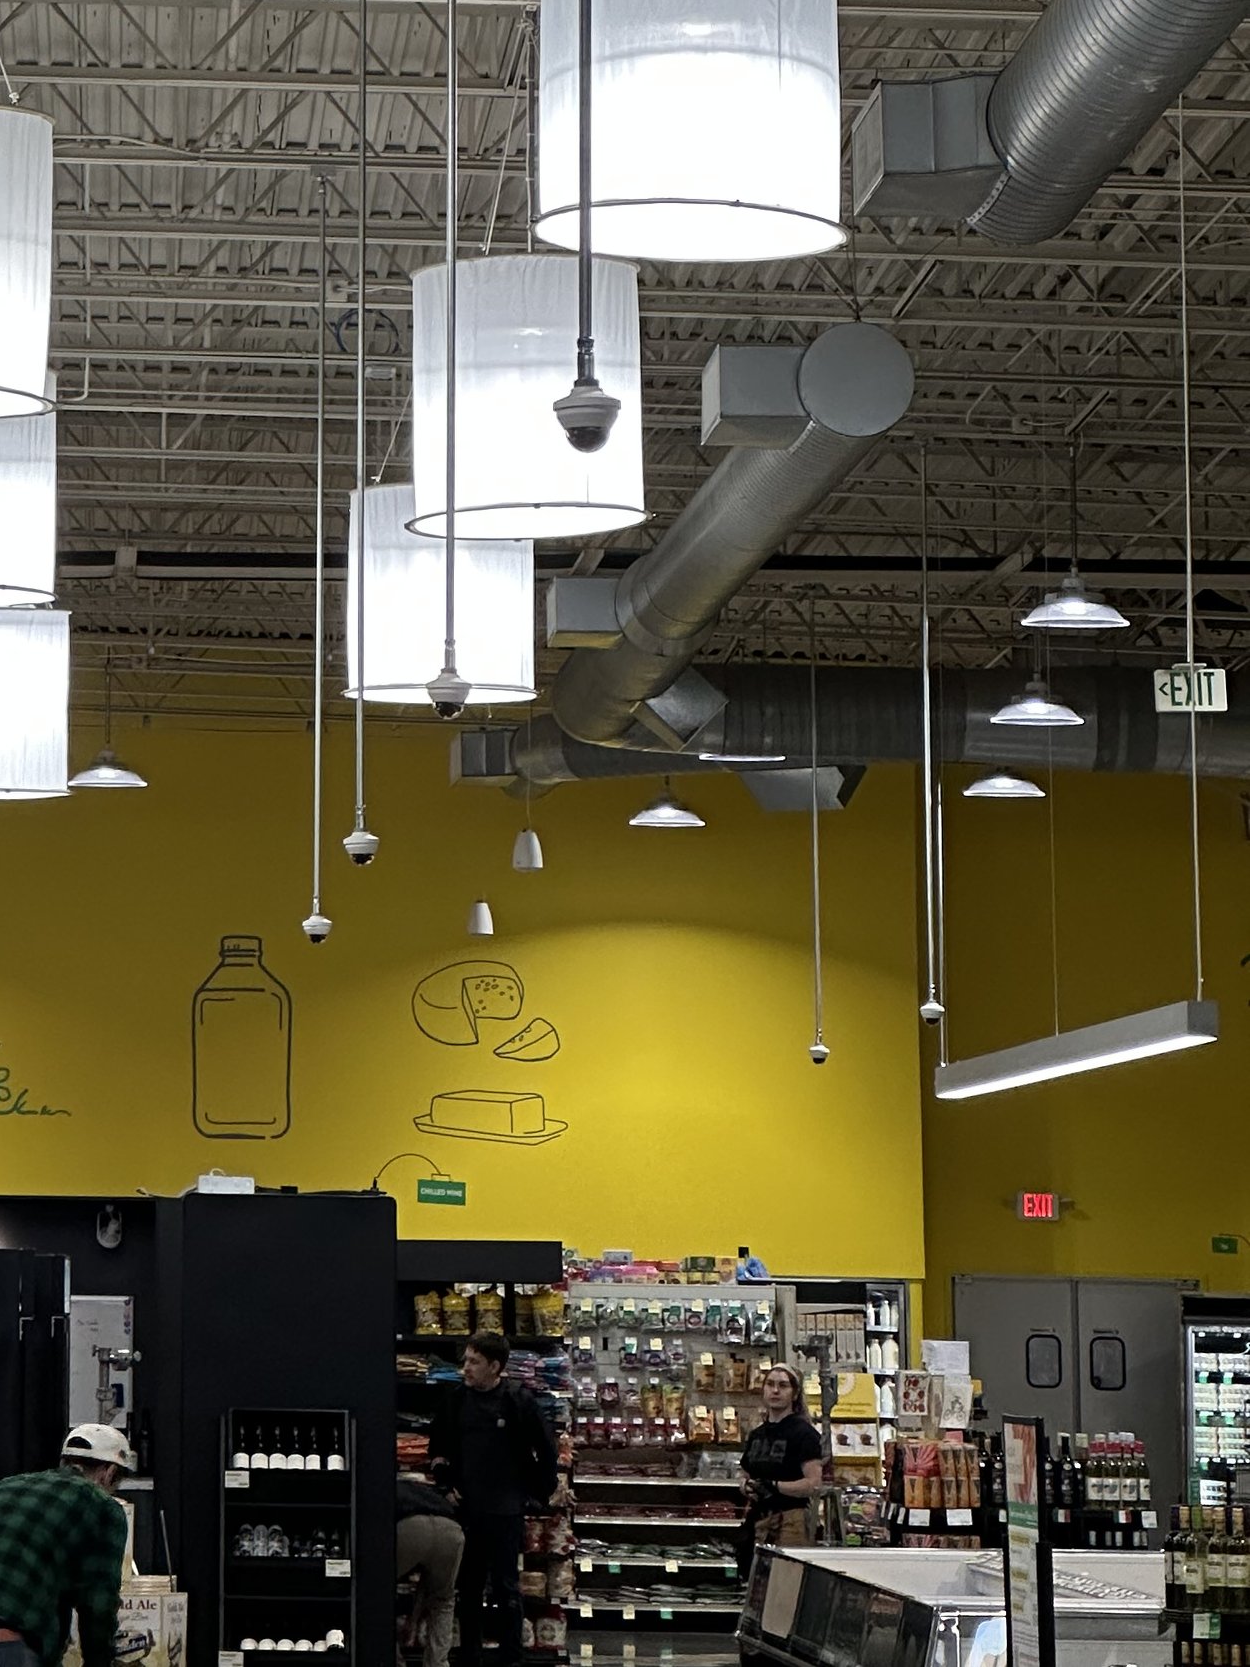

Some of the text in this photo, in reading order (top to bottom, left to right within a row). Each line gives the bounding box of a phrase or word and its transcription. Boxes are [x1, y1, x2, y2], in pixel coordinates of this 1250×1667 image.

[1170, 672, 1214, 706] EXIT
[1023, 1193, 1054, 1217] EXIT
[136, 1599, 158, 1610] Ale
